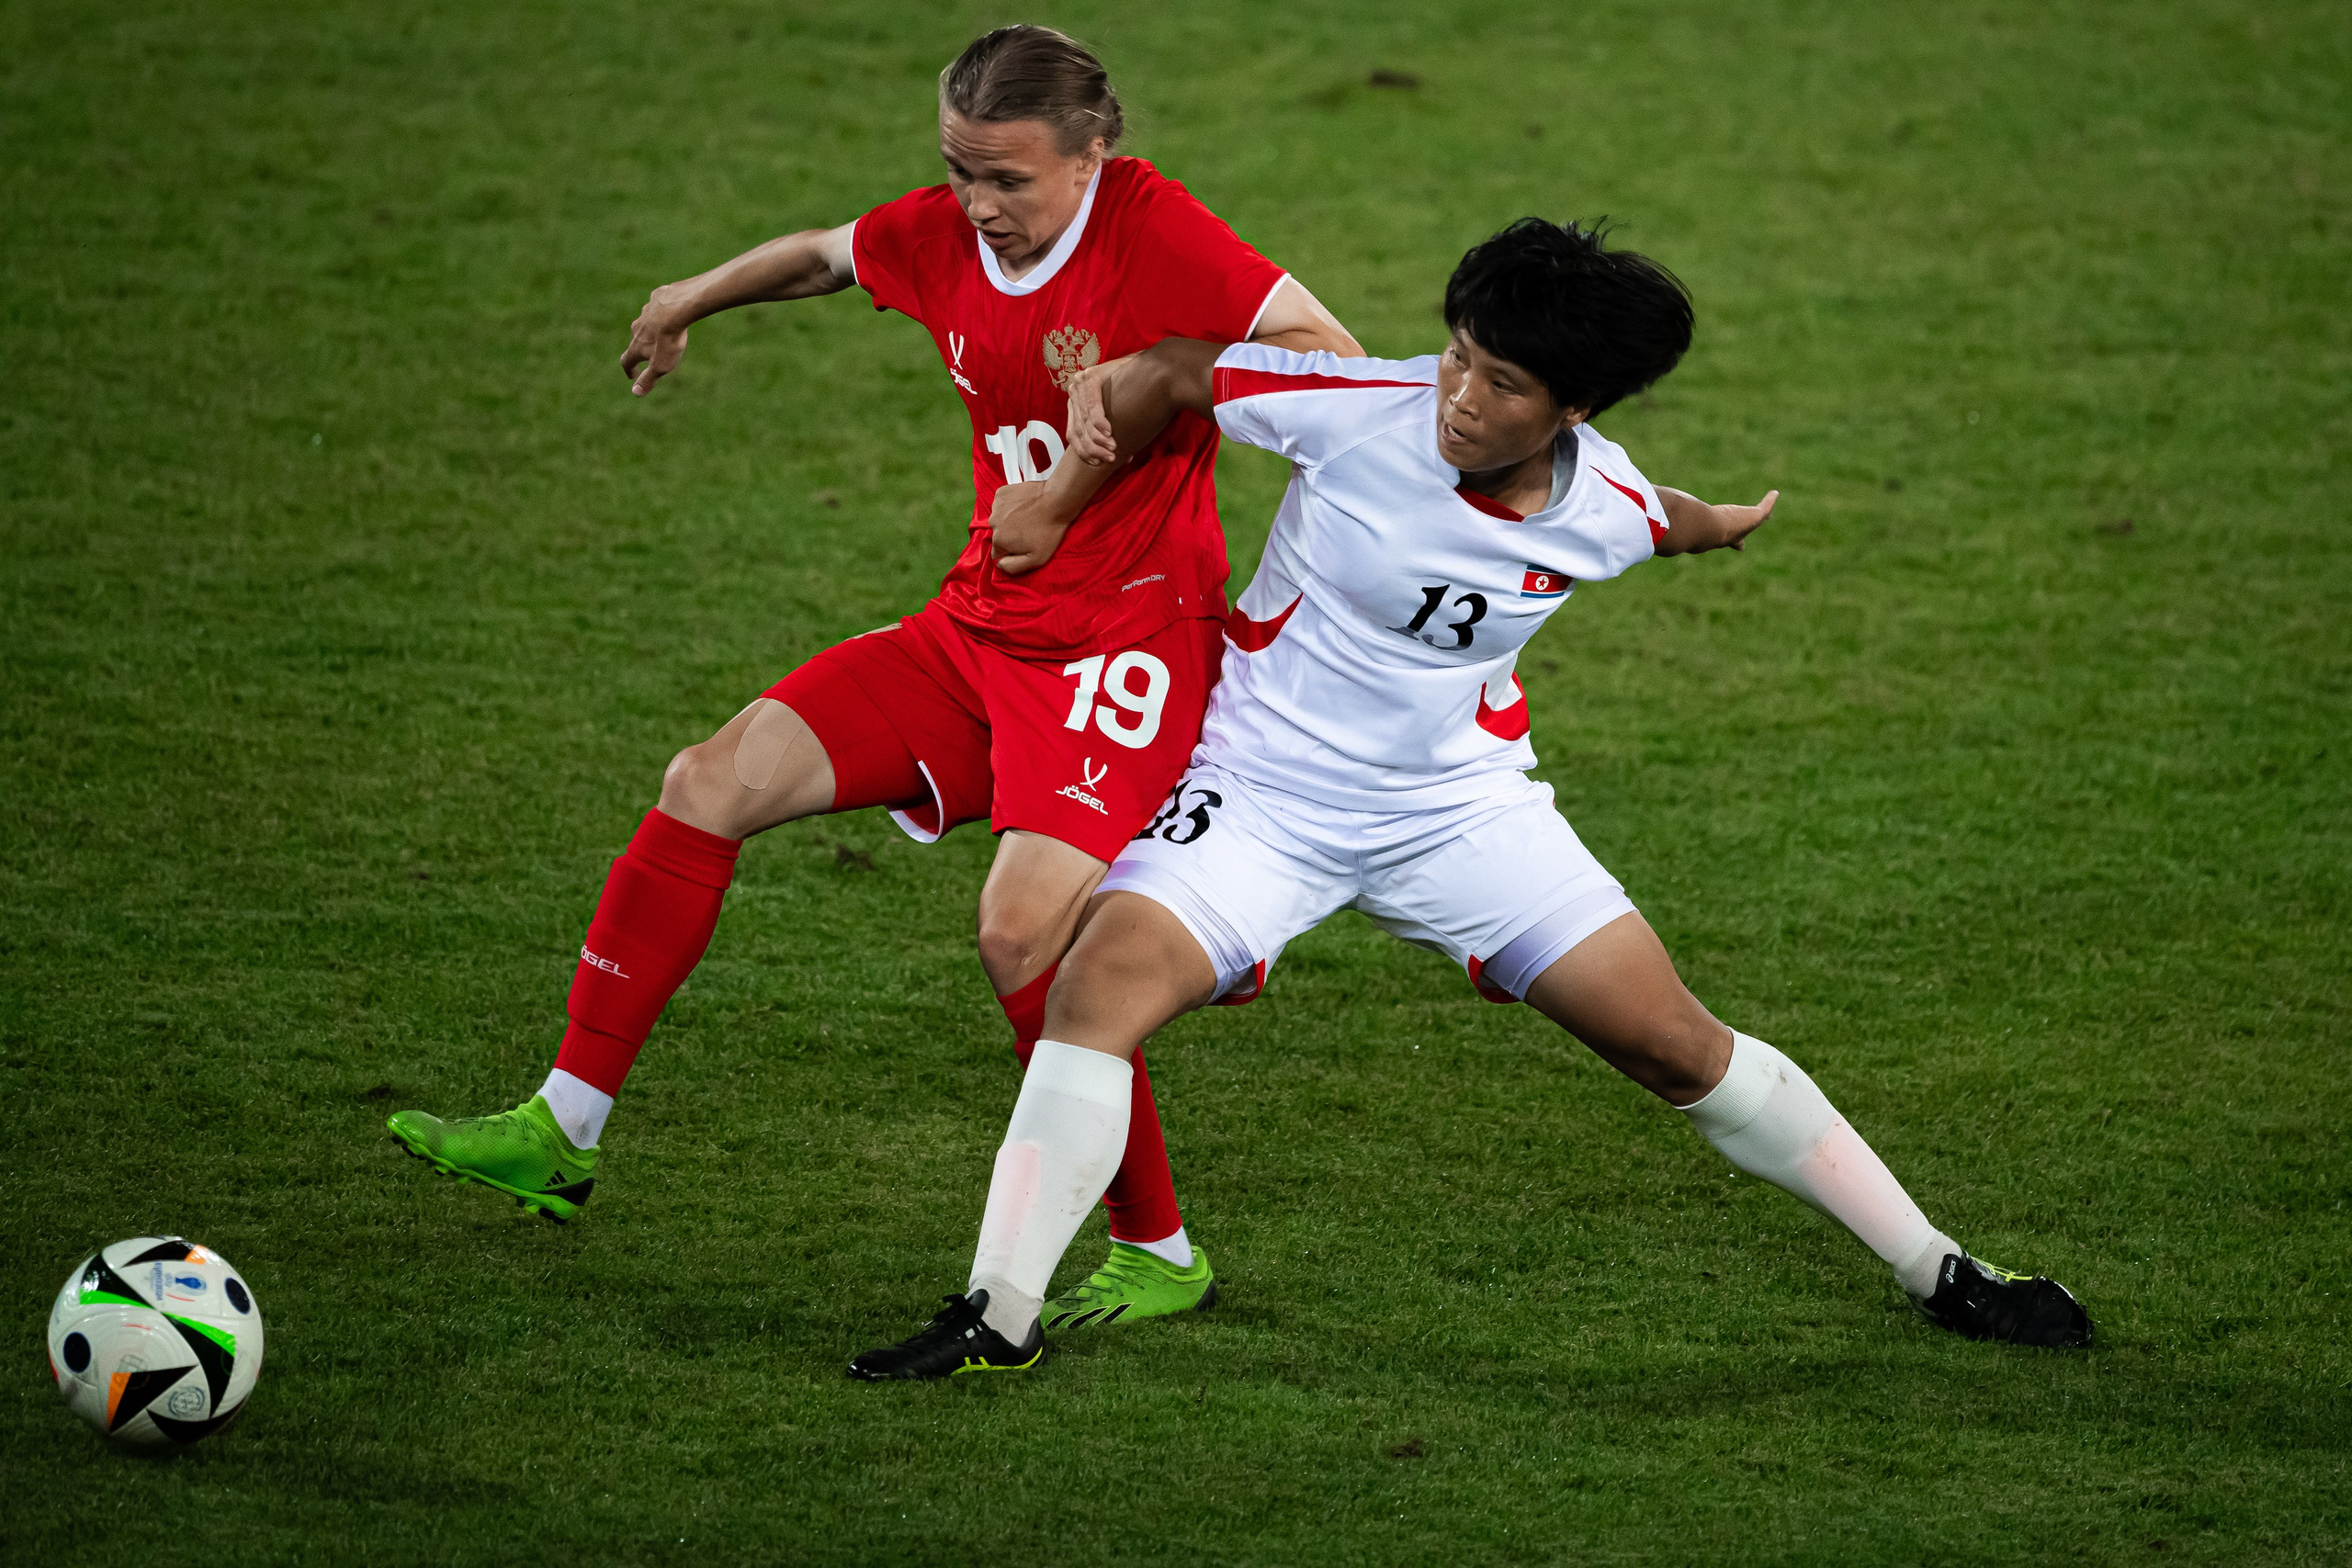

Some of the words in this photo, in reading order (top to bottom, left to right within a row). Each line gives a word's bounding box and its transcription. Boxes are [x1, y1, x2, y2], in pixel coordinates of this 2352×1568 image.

[1385, 583, 1487, 651] 13
[1062, 650, 1170, 750] 19
[1055, 784, 1109, 816] JÖGEL
[581, 944, 630, 979] ÖGEL
